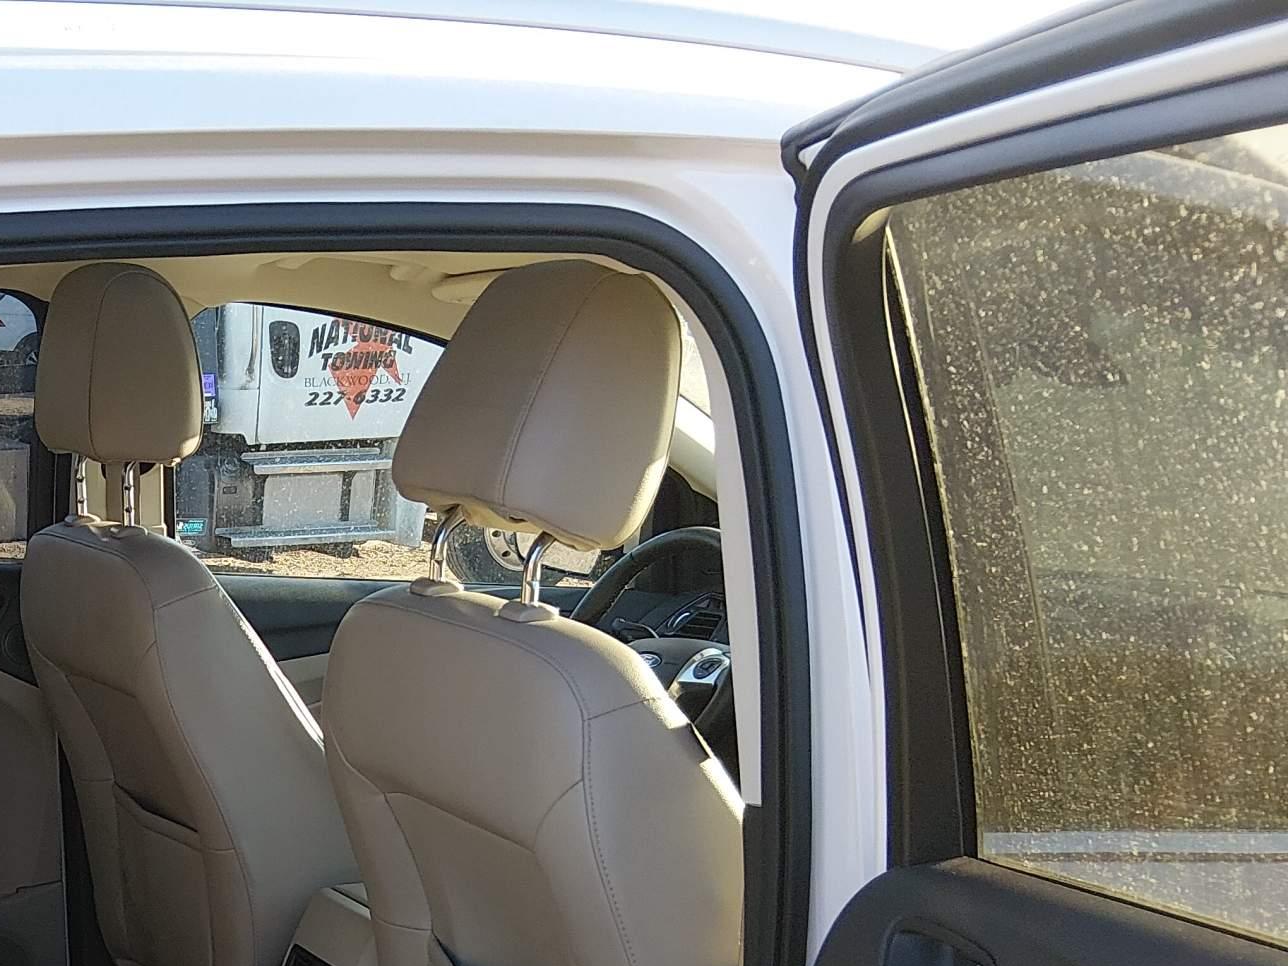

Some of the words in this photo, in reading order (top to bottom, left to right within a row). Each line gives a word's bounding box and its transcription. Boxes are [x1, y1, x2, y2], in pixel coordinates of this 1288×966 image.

[308, 319, 413, 358] NATIONAL
[321, 350, 397, 371] TOWING
[304, 387, 407, 406] 227-6332
